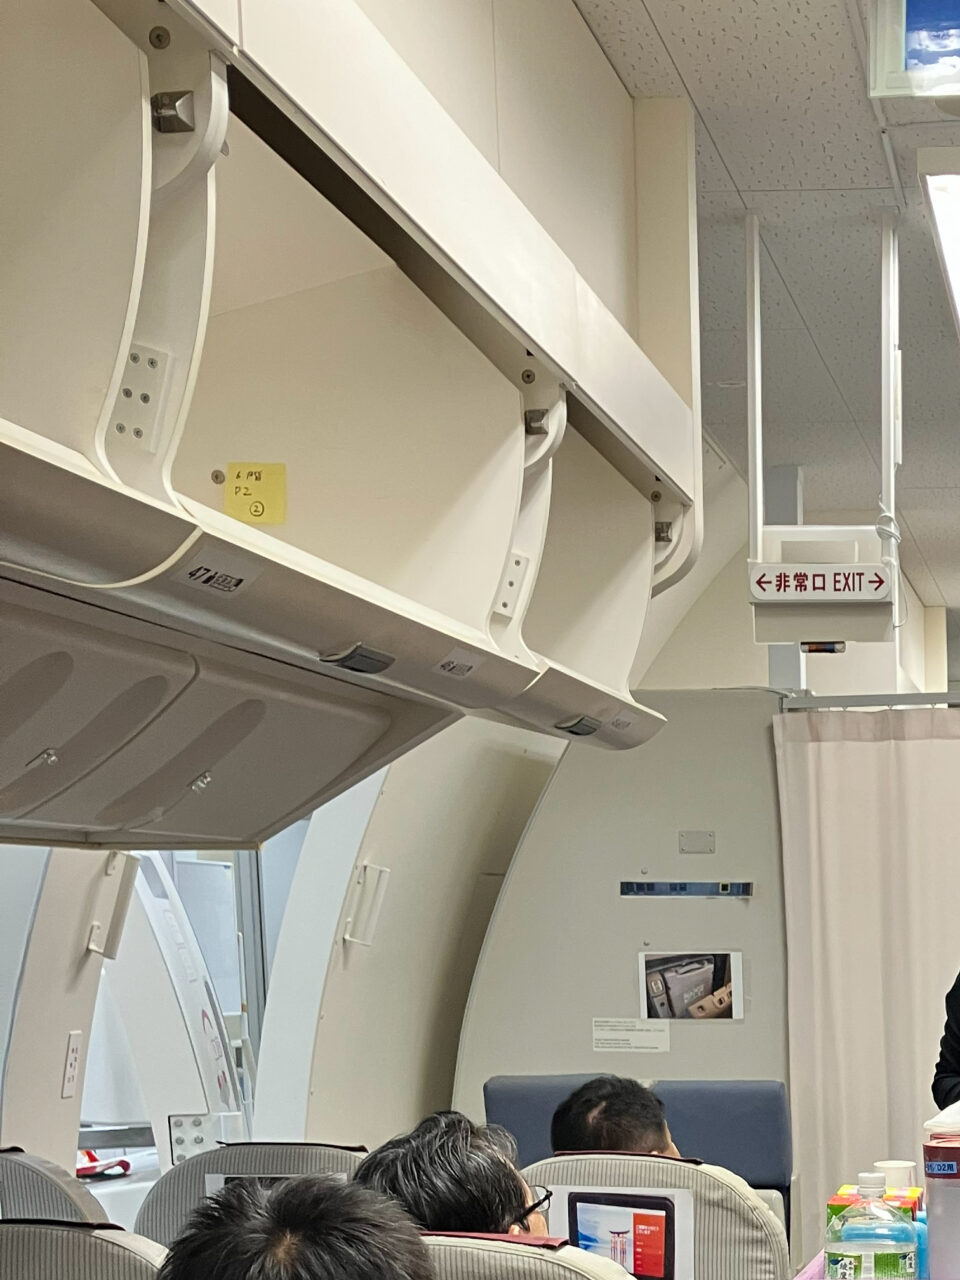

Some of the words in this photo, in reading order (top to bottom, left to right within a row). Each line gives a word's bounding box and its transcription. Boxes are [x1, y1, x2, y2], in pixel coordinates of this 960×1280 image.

[775, 572, 826, 592] 非常口
[833, 572, 865, 592] EXIT
